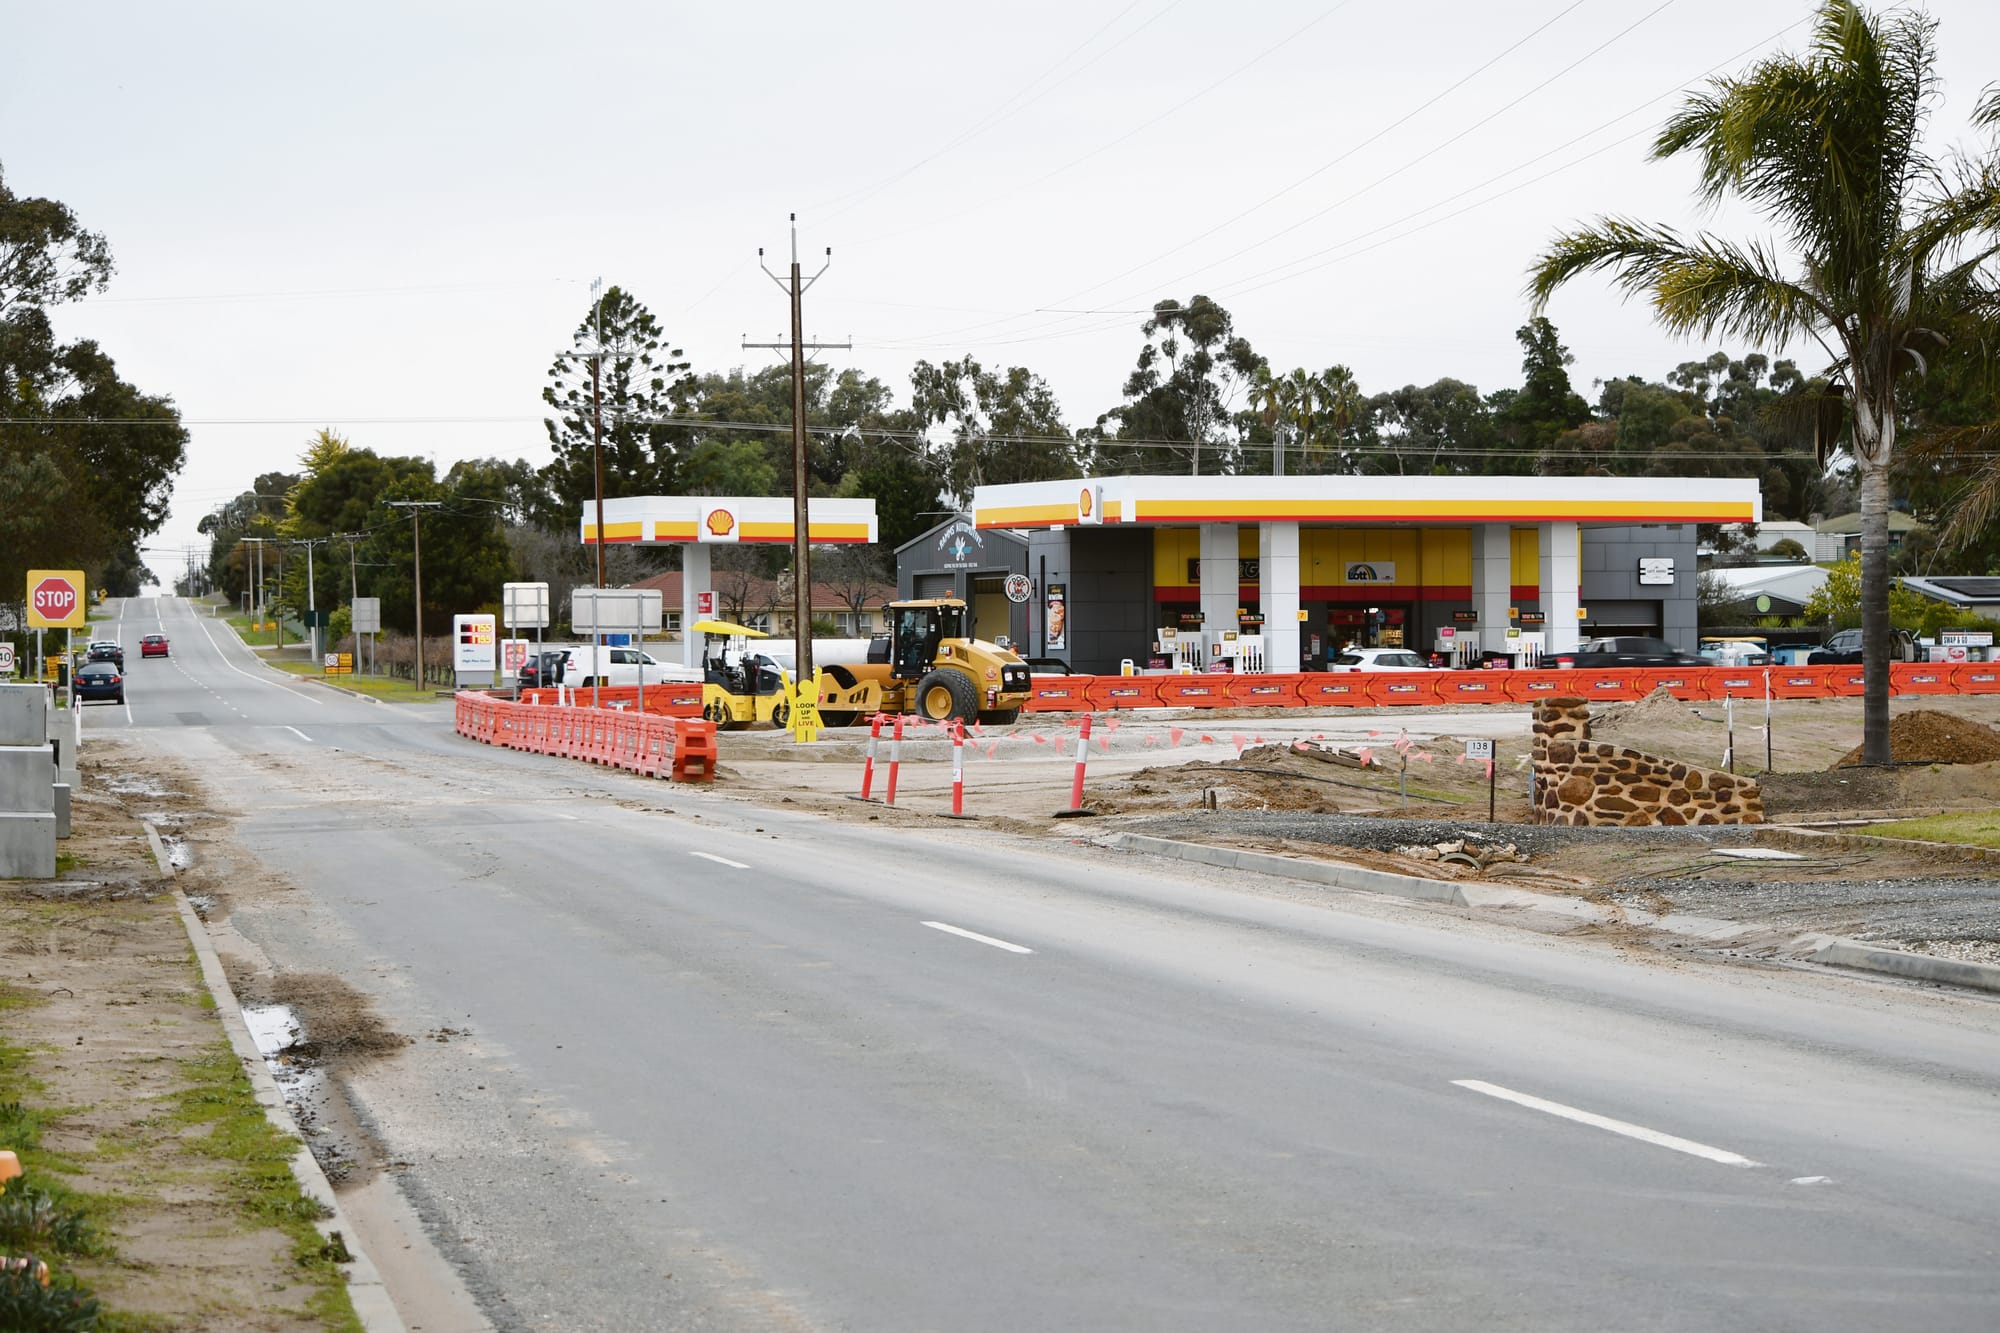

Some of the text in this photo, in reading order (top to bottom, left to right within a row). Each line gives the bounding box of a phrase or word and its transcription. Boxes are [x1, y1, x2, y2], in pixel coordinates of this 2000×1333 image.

[36, 591, 74, 607] STOP
[1011, 592, 1027, 600] WASH
[1944, 636, 1957, 644] SWAP
[1472, 742, 1488, 750] 138
